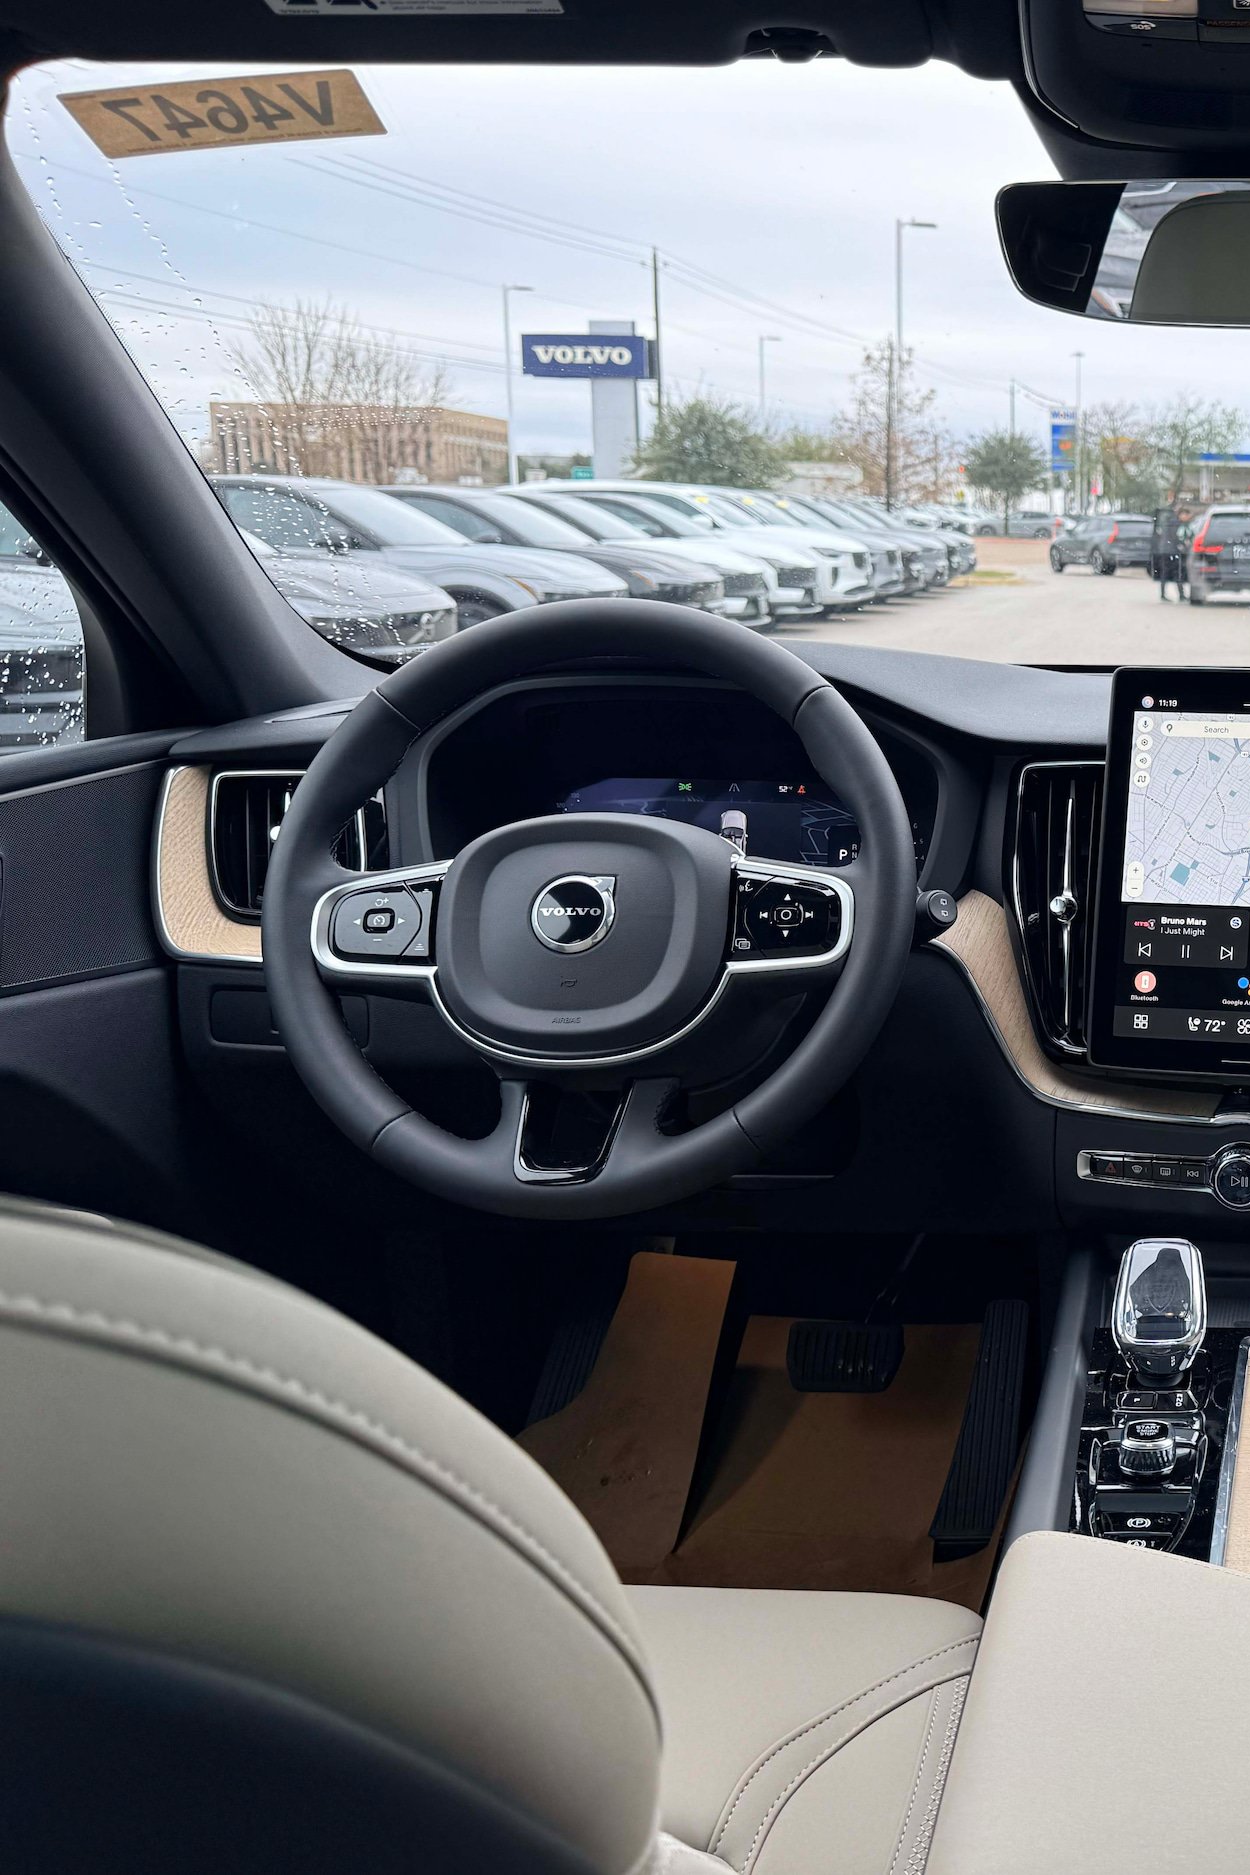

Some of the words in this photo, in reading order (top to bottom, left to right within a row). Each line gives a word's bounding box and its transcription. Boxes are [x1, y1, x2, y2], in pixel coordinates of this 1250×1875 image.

[1130, 23, 1151, 31] SOS
[531, 345, 633, 366] VOLVO
[1159, 699, 1178, 708] 11:19
[1204, 726, 1230, 734] Search
[839, 848, 848, 861] P
[540, 907, 601, 917] VOLVO
[1160, 916, 1185, 925] Bruno
[1186, 917, 1207, 926] Mars
[1164, 927, 1181, 935] Just
[1182, 928, 1205, 937] Might
[1130, 994, 1159, 1002] Bluetooth
[1222, 998, 1243, 1006] Google
[1203, 1018, 1226, 1033] 72°
